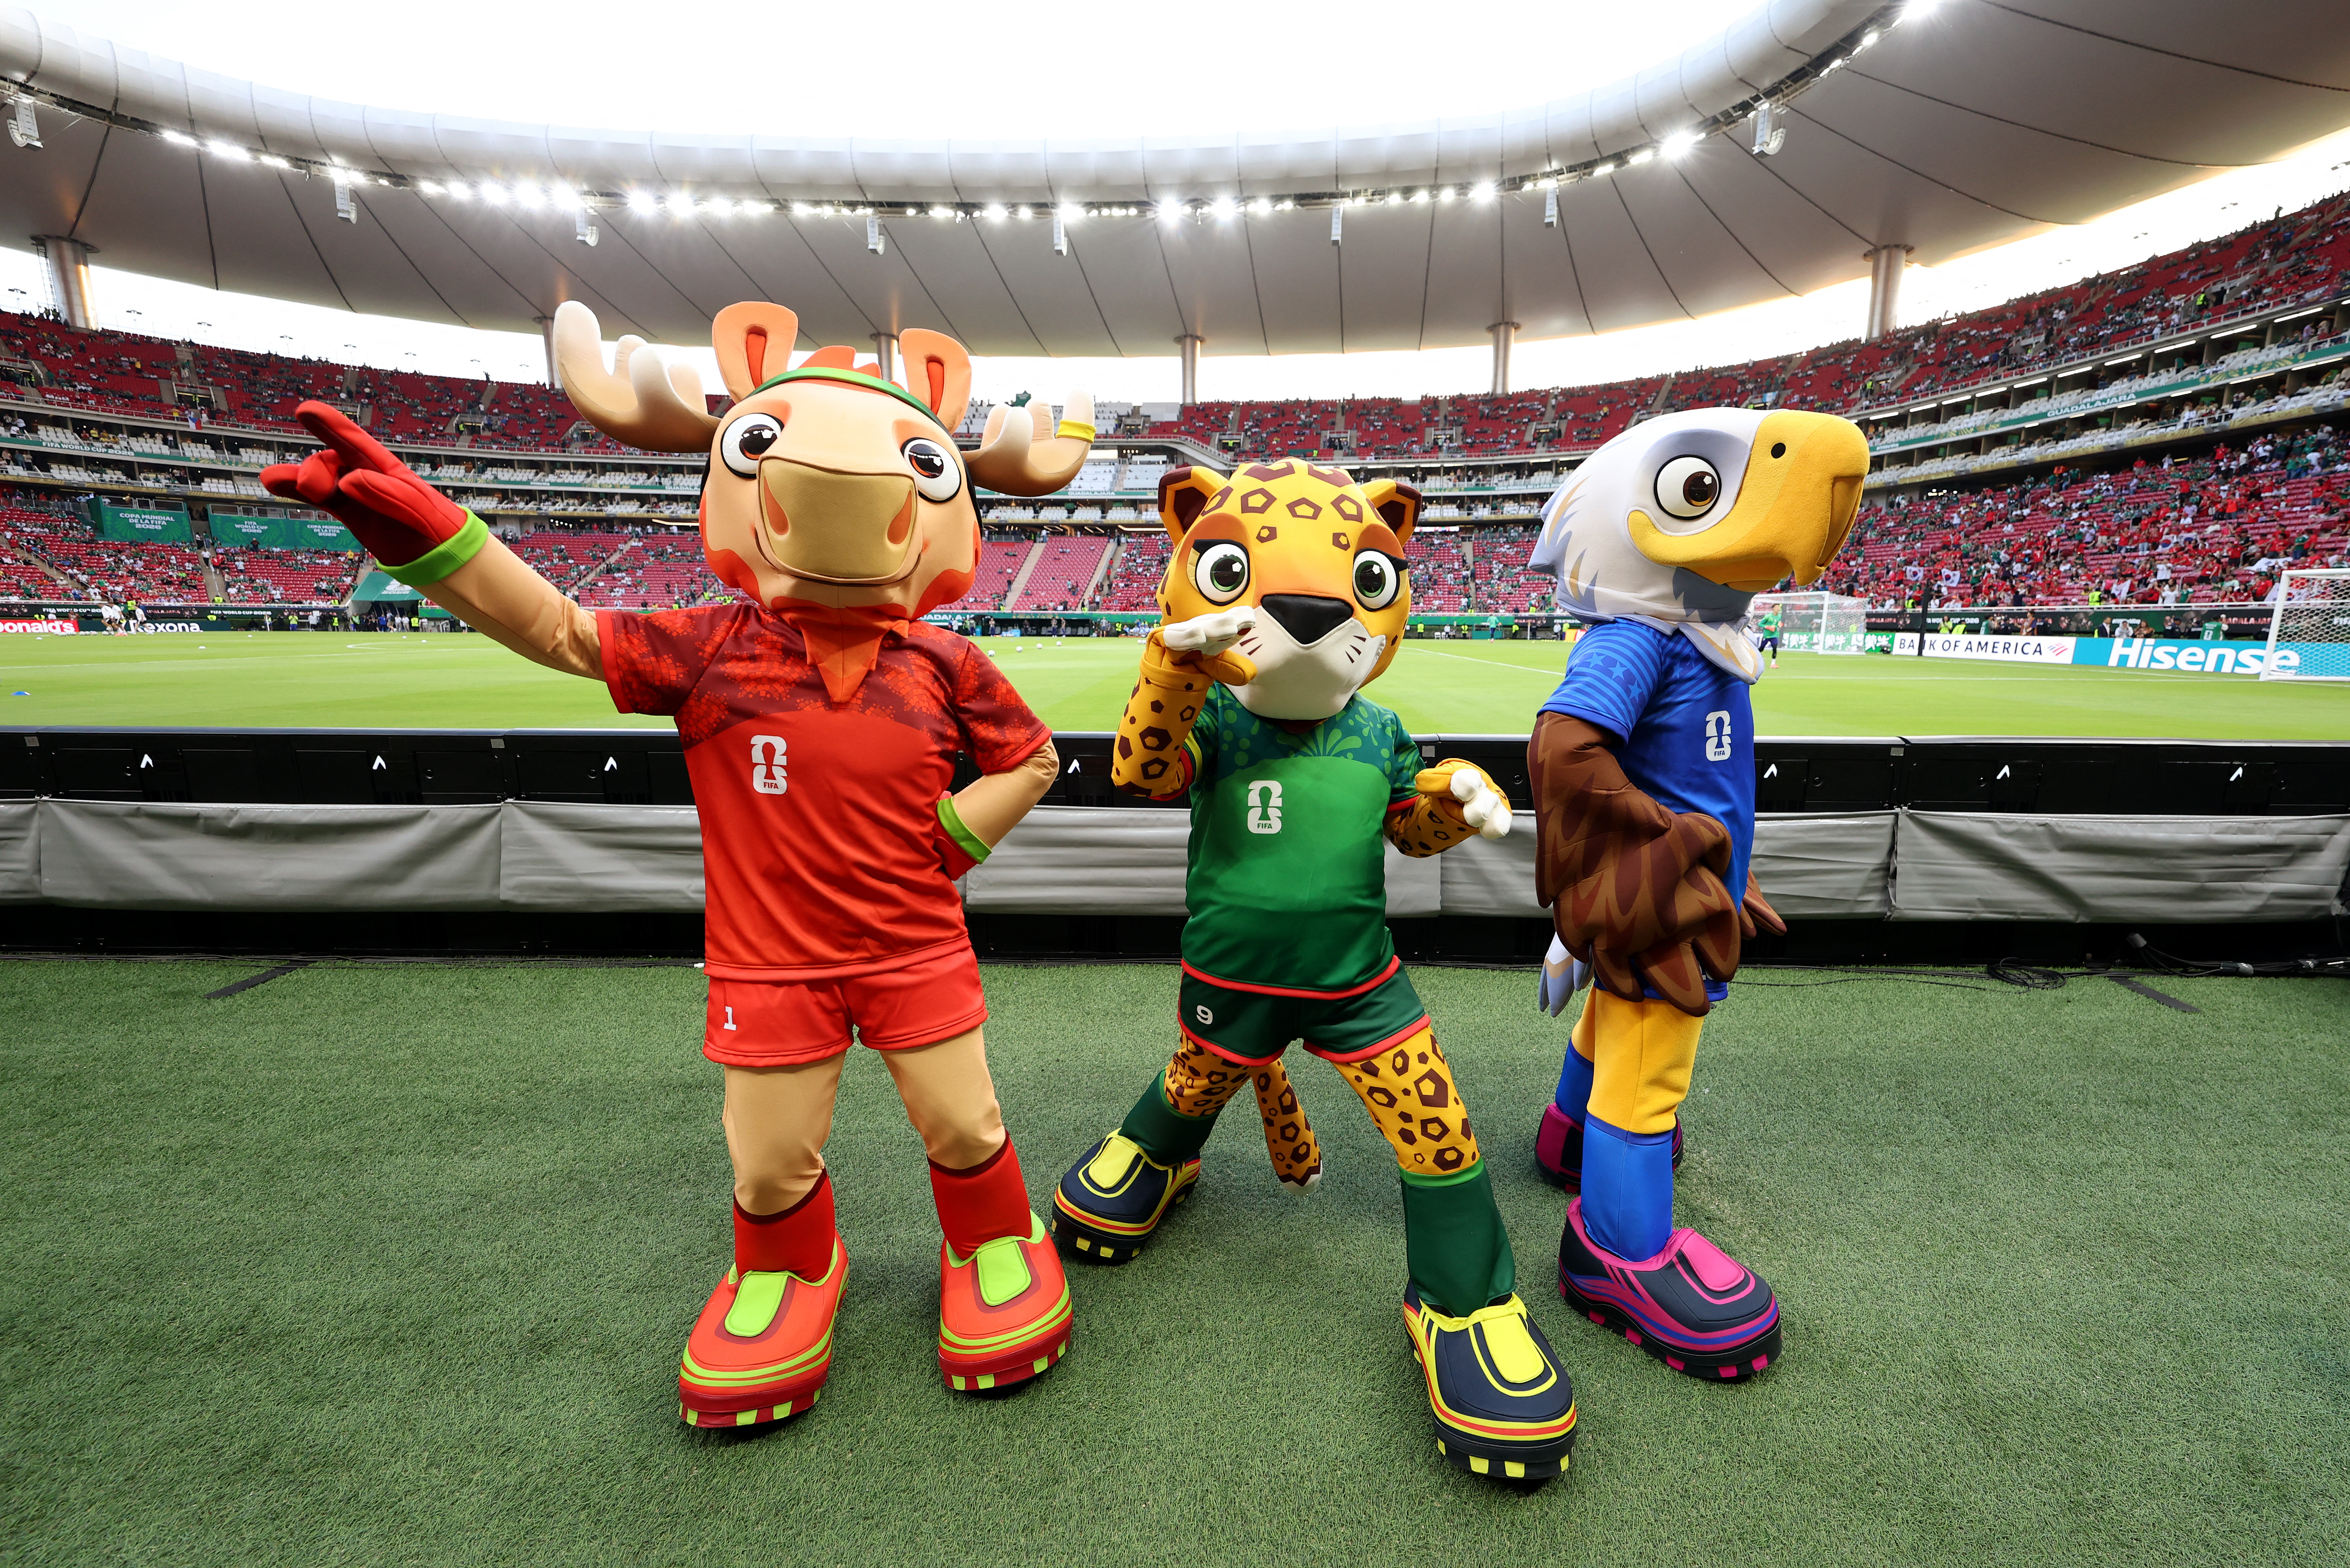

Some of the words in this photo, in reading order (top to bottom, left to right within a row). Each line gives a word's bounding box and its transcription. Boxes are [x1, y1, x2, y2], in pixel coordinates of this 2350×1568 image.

[2047, 393, 2136, 417] GUADALAJARA
[0, 621, 75, 633] onald's
[1942, 640, 1961, 652] OF
[1964, 641, 2043, 656] AMERICA
[2108, 638, 2300, 676] Hisense
[723, 1005, 737, 1031] 1
[1196, 1005, 1213, 1025] 9
